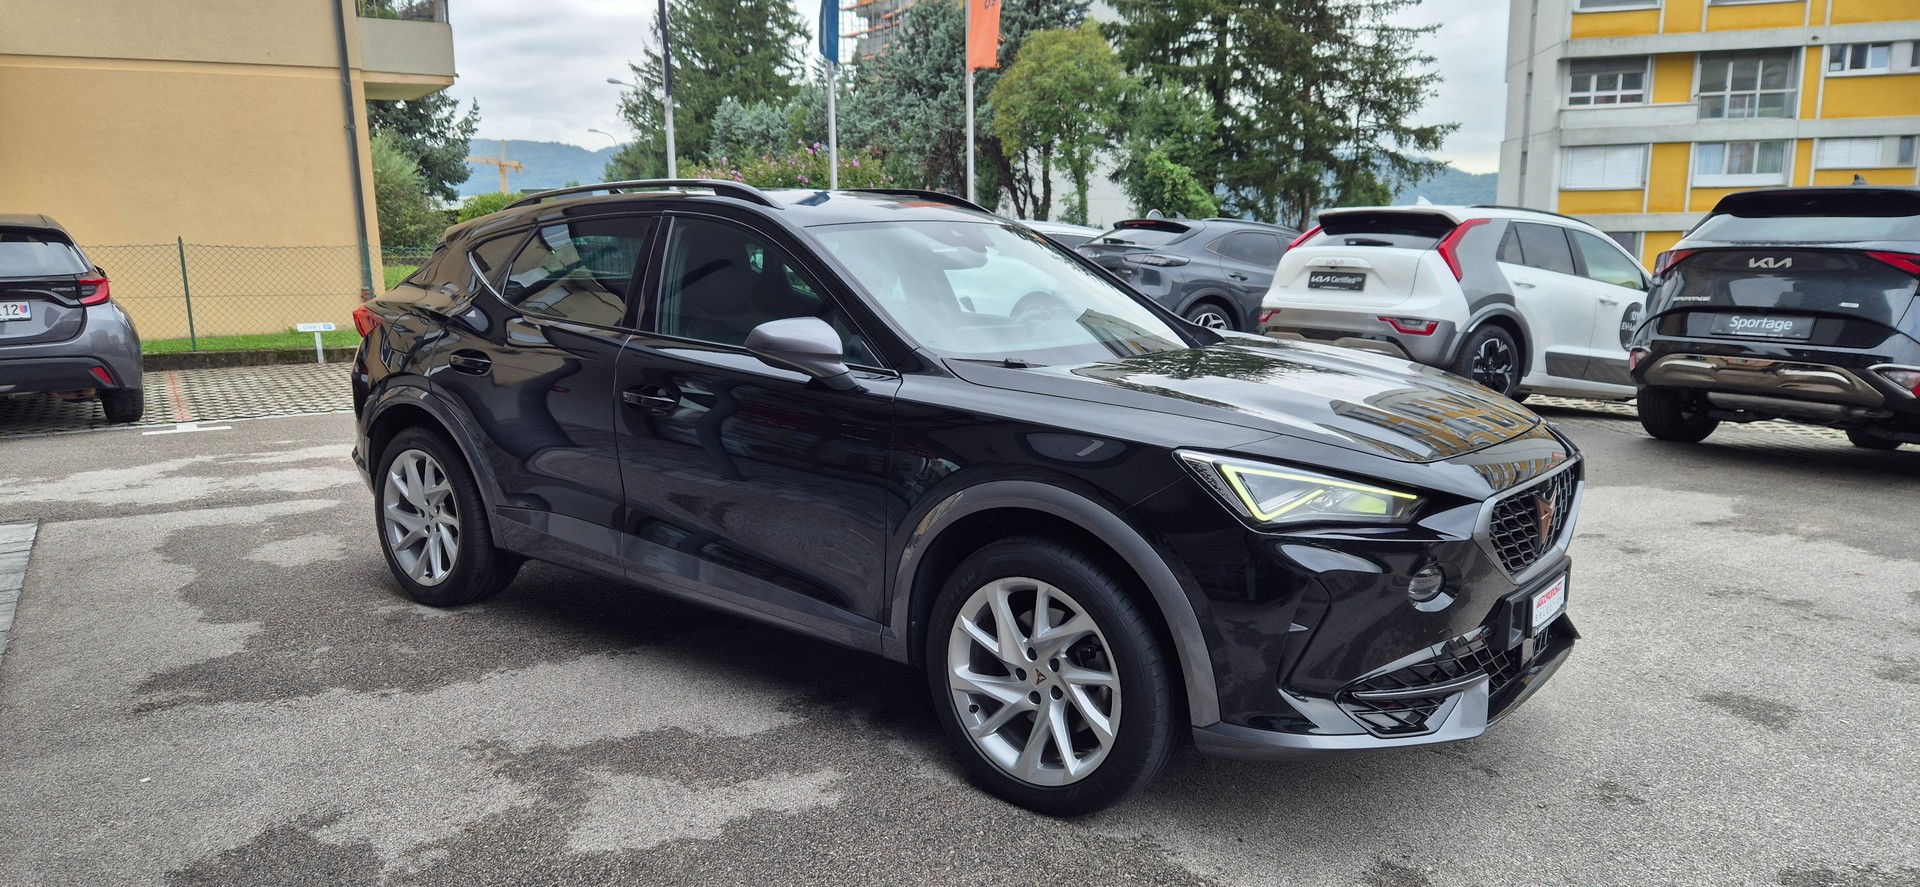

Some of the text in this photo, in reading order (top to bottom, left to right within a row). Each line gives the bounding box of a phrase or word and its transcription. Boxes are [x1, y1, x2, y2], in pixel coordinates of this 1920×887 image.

[1747, 257, 1793, 269] KIA
[1311, 275, 1331, 283] KIA
[1330, 275, 1357, 285] Certified
[0, 304, 19, 317] 12
[1729, 315, 1794, 332] Sportage
